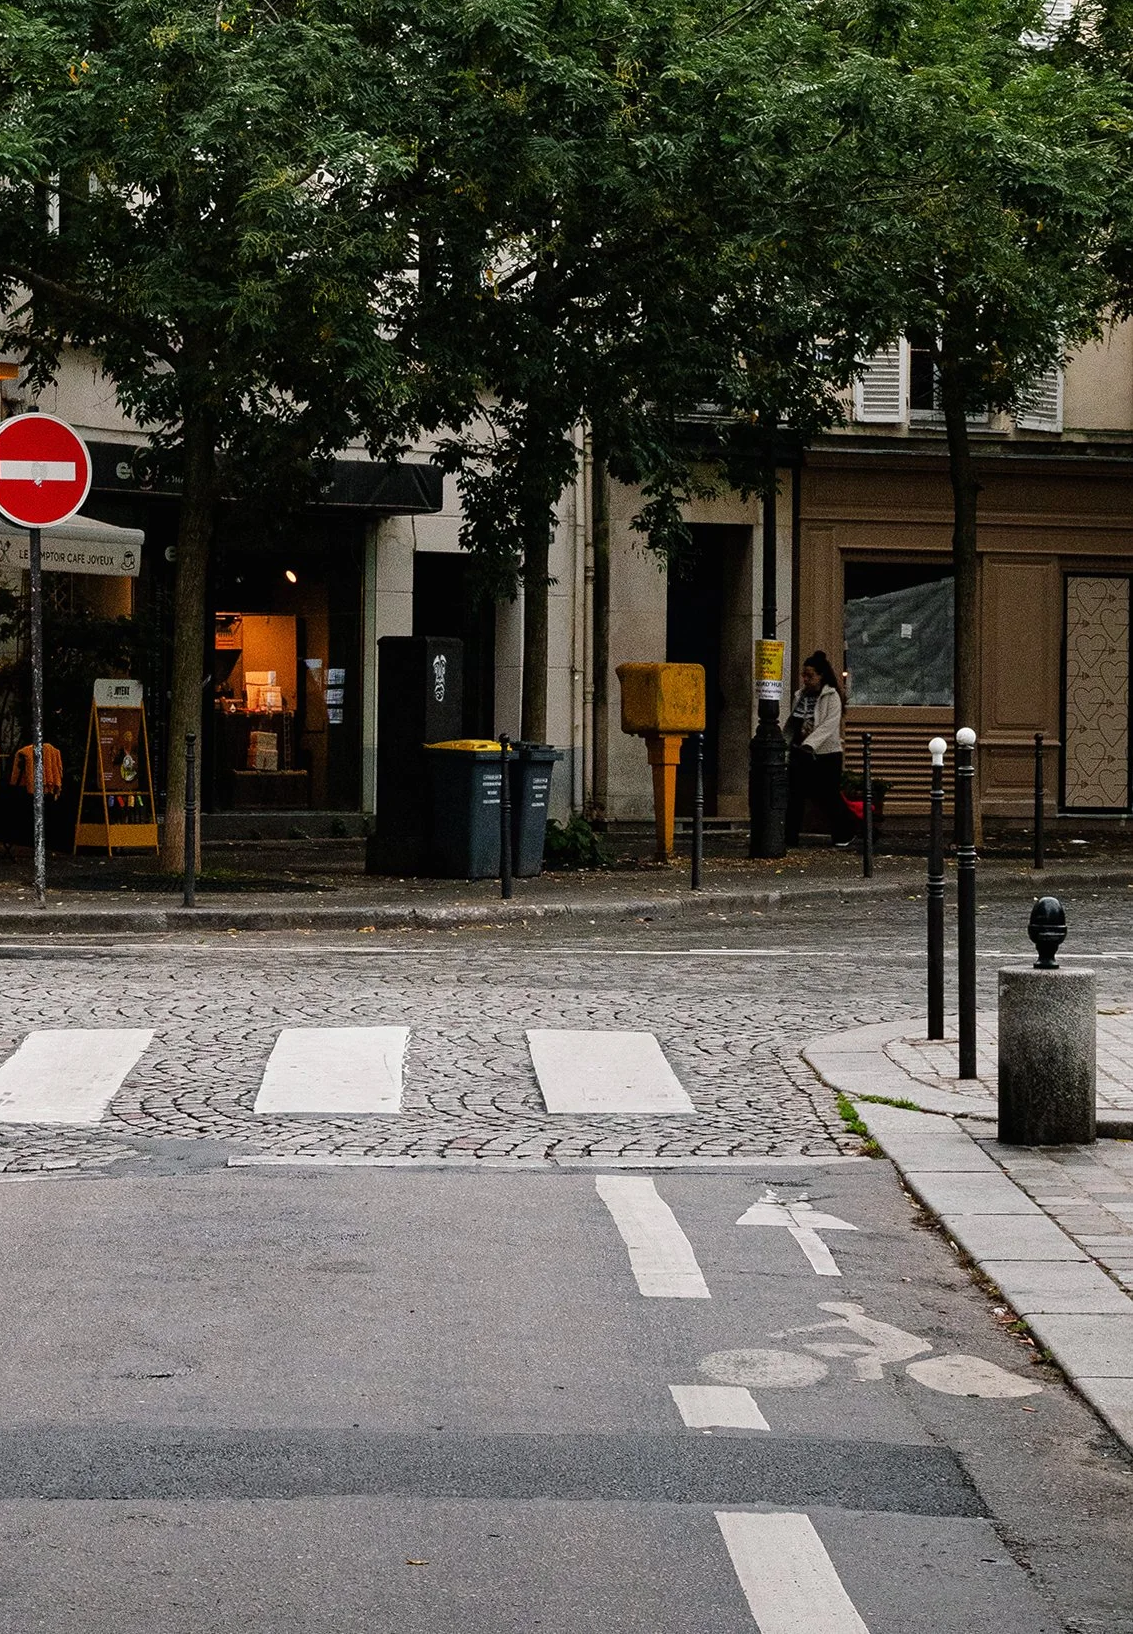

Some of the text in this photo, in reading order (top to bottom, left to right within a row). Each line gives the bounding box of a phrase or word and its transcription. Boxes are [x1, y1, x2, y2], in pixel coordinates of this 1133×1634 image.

[19, 549, 29, 560] LE
[40, 550, 66, 563] MPTOIR
[87, 554, 115, 566] JOYEUX
